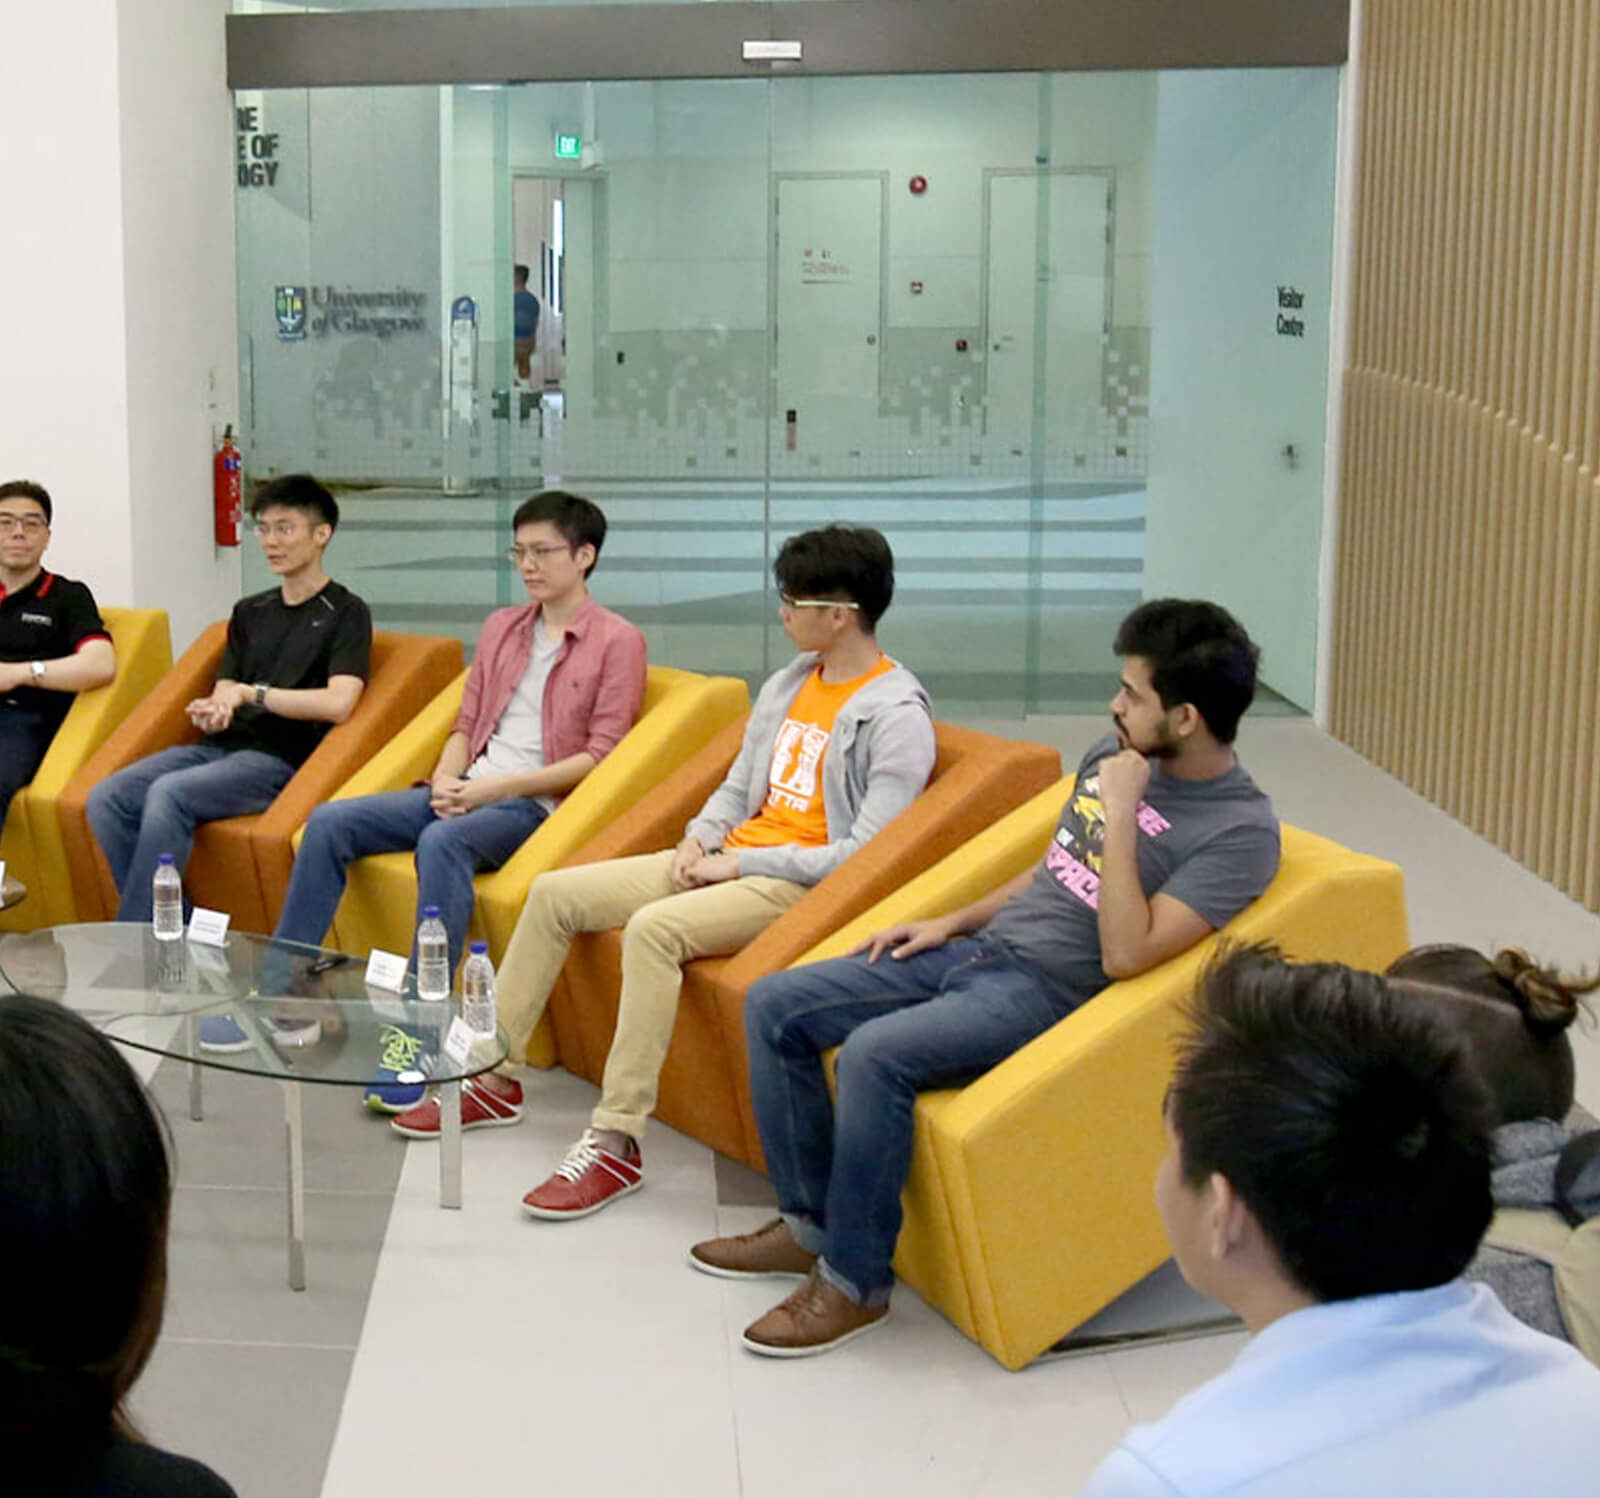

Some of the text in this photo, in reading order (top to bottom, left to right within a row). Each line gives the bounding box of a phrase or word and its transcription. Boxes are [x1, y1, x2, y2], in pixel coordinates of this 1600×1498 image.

[251, 133, 279, 159] OF
[311, 284, 427, 315] University
[331, 308, 426, 341] Glasgow
